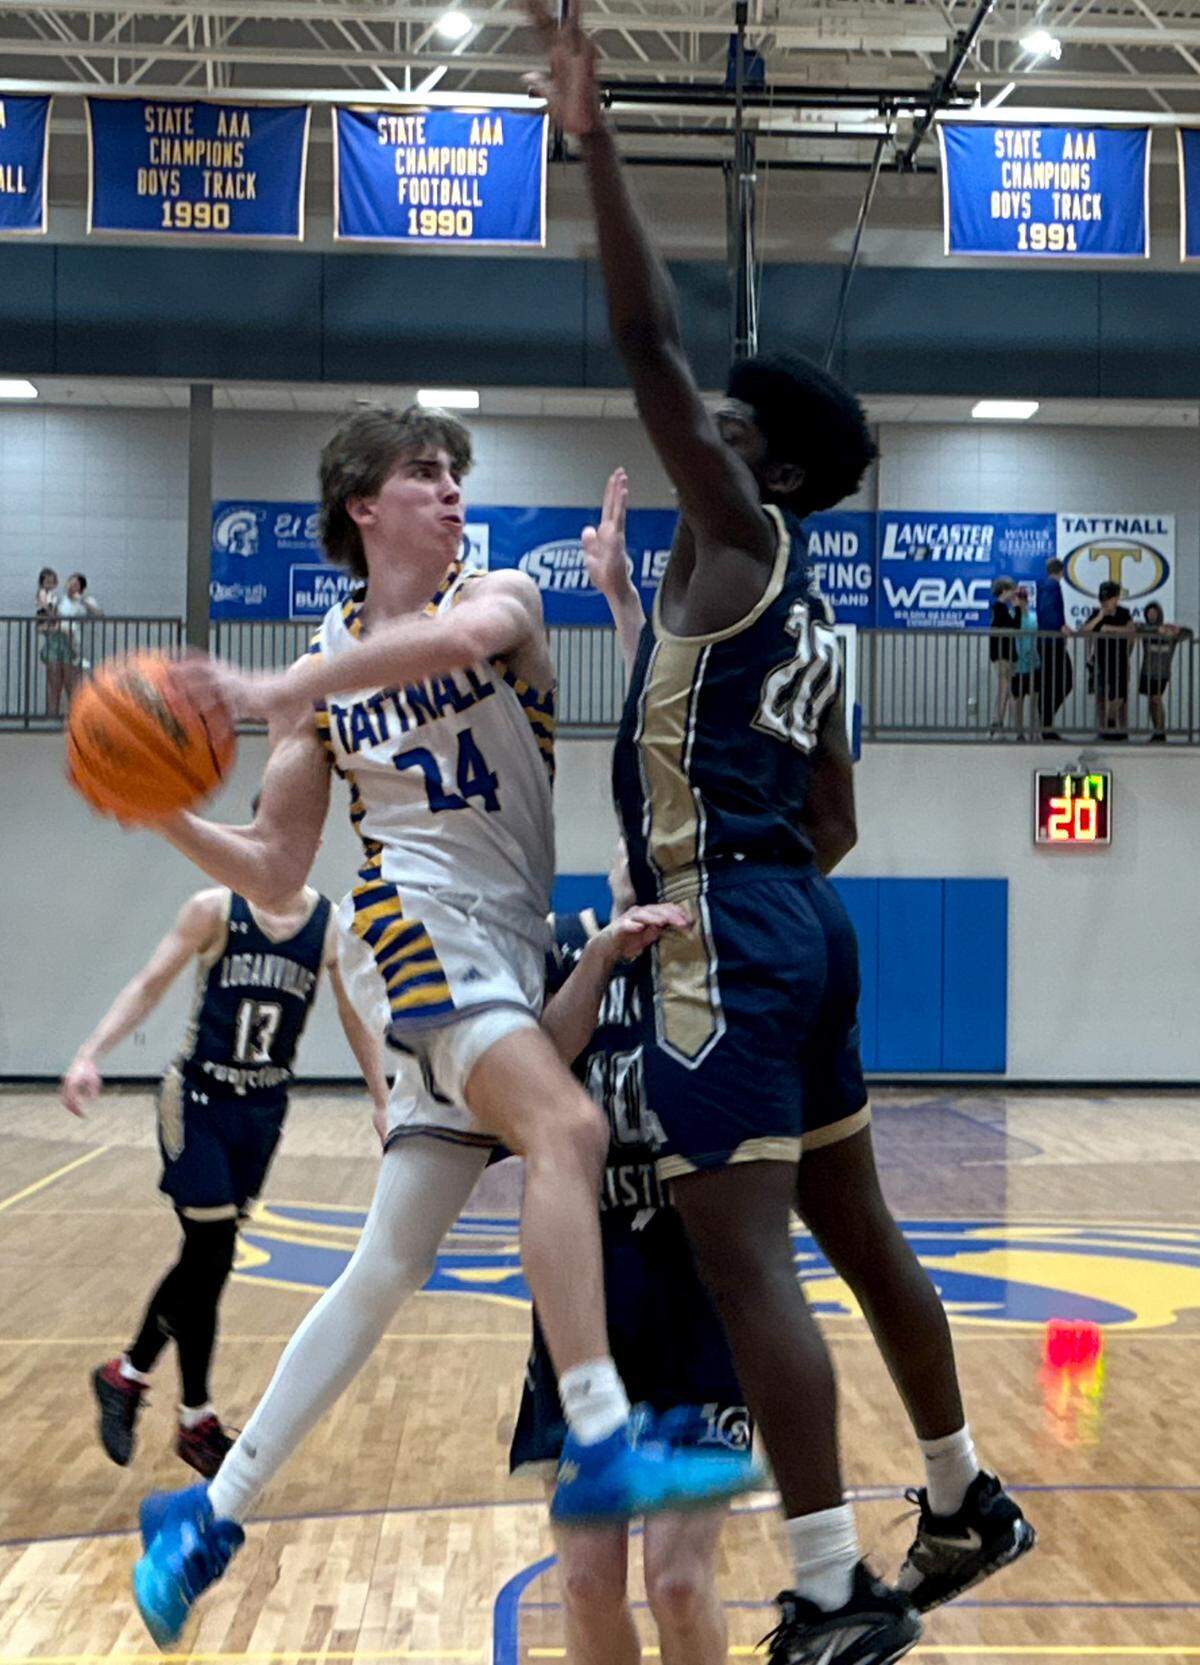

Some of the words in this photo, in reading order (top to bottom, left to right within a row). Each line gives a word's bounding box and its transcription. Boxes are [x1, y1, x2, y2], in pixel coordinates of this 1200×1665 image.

[144, 105, 194, 135] STATE
[217, 110, 251, 138] AAA
[377, 116, 426, 146] STATE
[470, 117, 504, 146] AAA
[149, 137, 245, 168] CHAMPIONS
[994, 129, 1042, 159] STATE
[1062, 132, 1096, 160] AAA
[395, 147, 488, 176] CHAMPIONS
[1001, 160, 1090, 190] CHAMPIONS
[137, 168, 180, 196] BOYS
[204, 171, 256, 200] TRACK
[398, 177, 482, 207] FOOTBALL
[161, 201, 230, 230] 1990
[990, 190, 1032, 219] BOYS
[1051, 191, 1102, 221] TRACK
[408, 208, 473, 237] 1990
[1017, 222, 1077, 250] 1991
[882, 523, 994, 560] LANCASTER
[1063, 519, 1168, 535] TATTNALL
[931, 546, 991, 562] TIRE
[331, 667, 496, 754] TATTNALL
[392, 727, 501, 813] 24
[1048, 797, 1097, 841] 20
[235, 999, 283, 1063] 13
